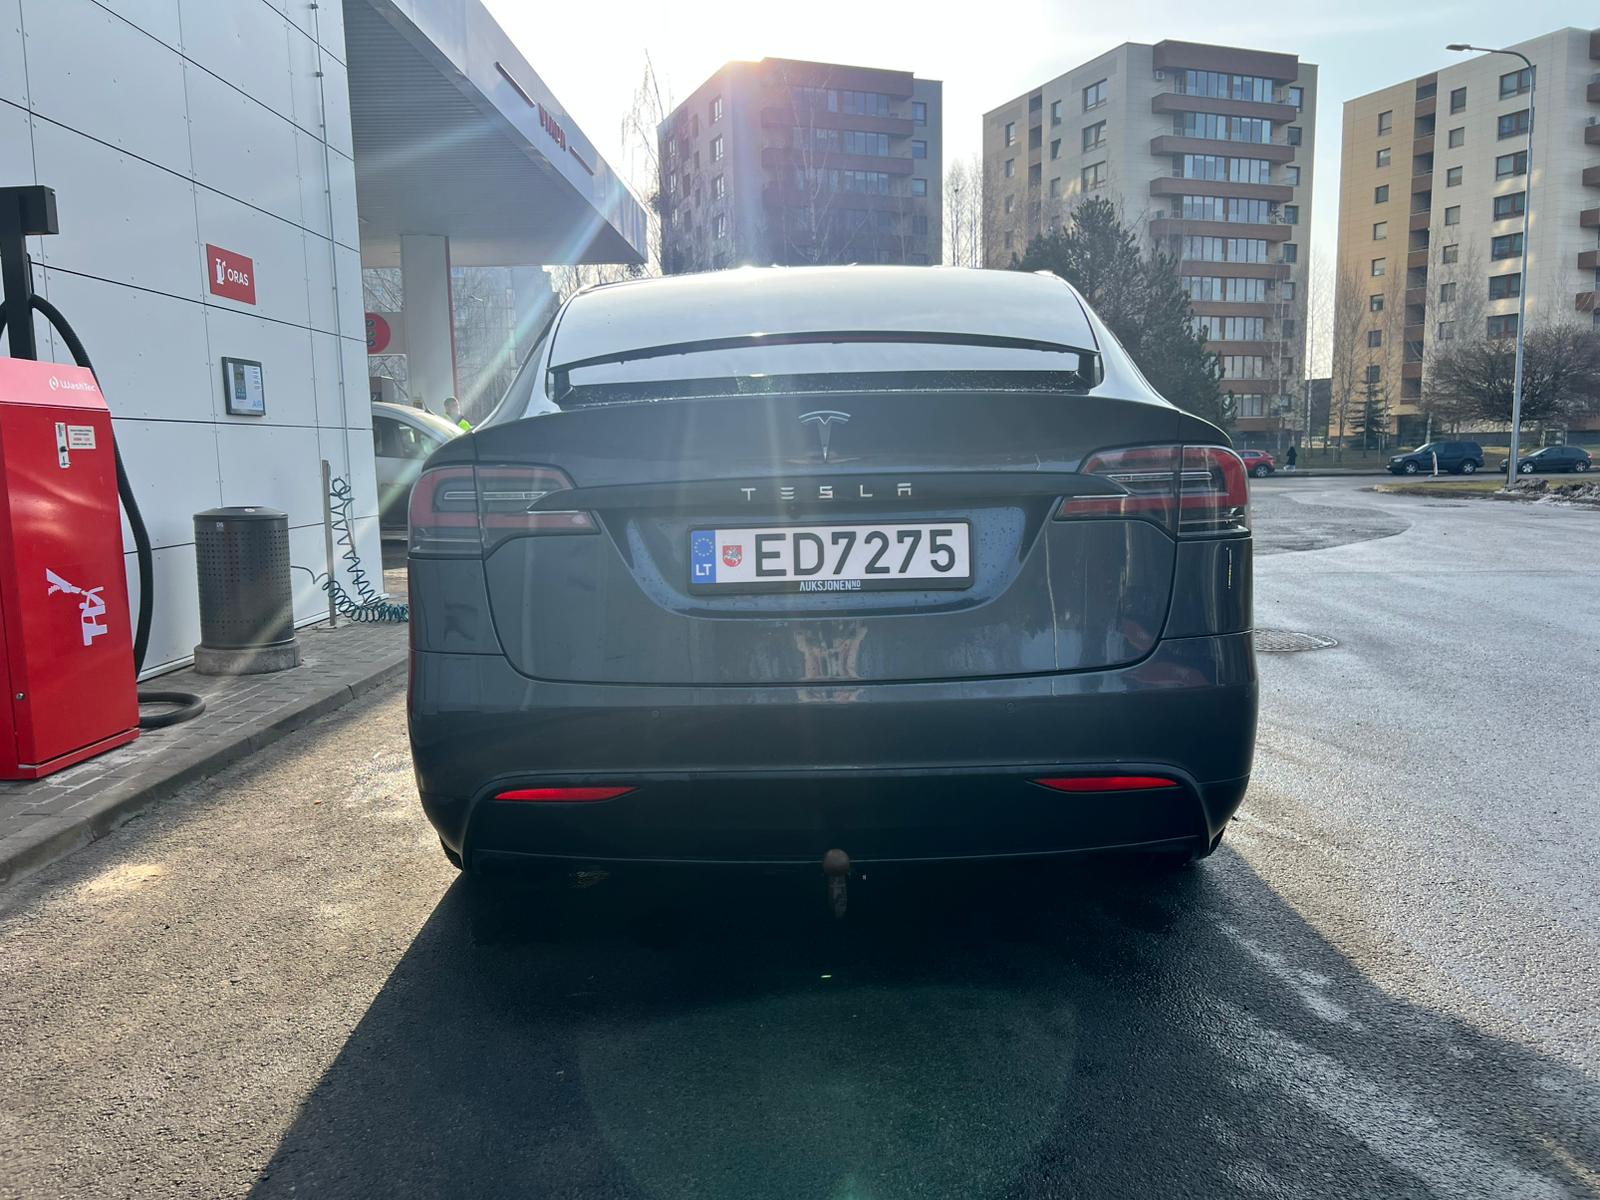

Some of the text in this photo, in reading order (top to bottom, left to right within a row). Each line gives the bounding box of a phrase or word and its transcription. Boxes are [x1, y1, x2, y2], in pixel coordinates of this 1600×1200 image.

[227, 268, 249, 286] ORAS
[59, 379, 96, 392] WashTec
[740, 482, 912, 501] TESLA
[754, 529, 956, 577] ED7275
[695, 563, 712, 576] LT
